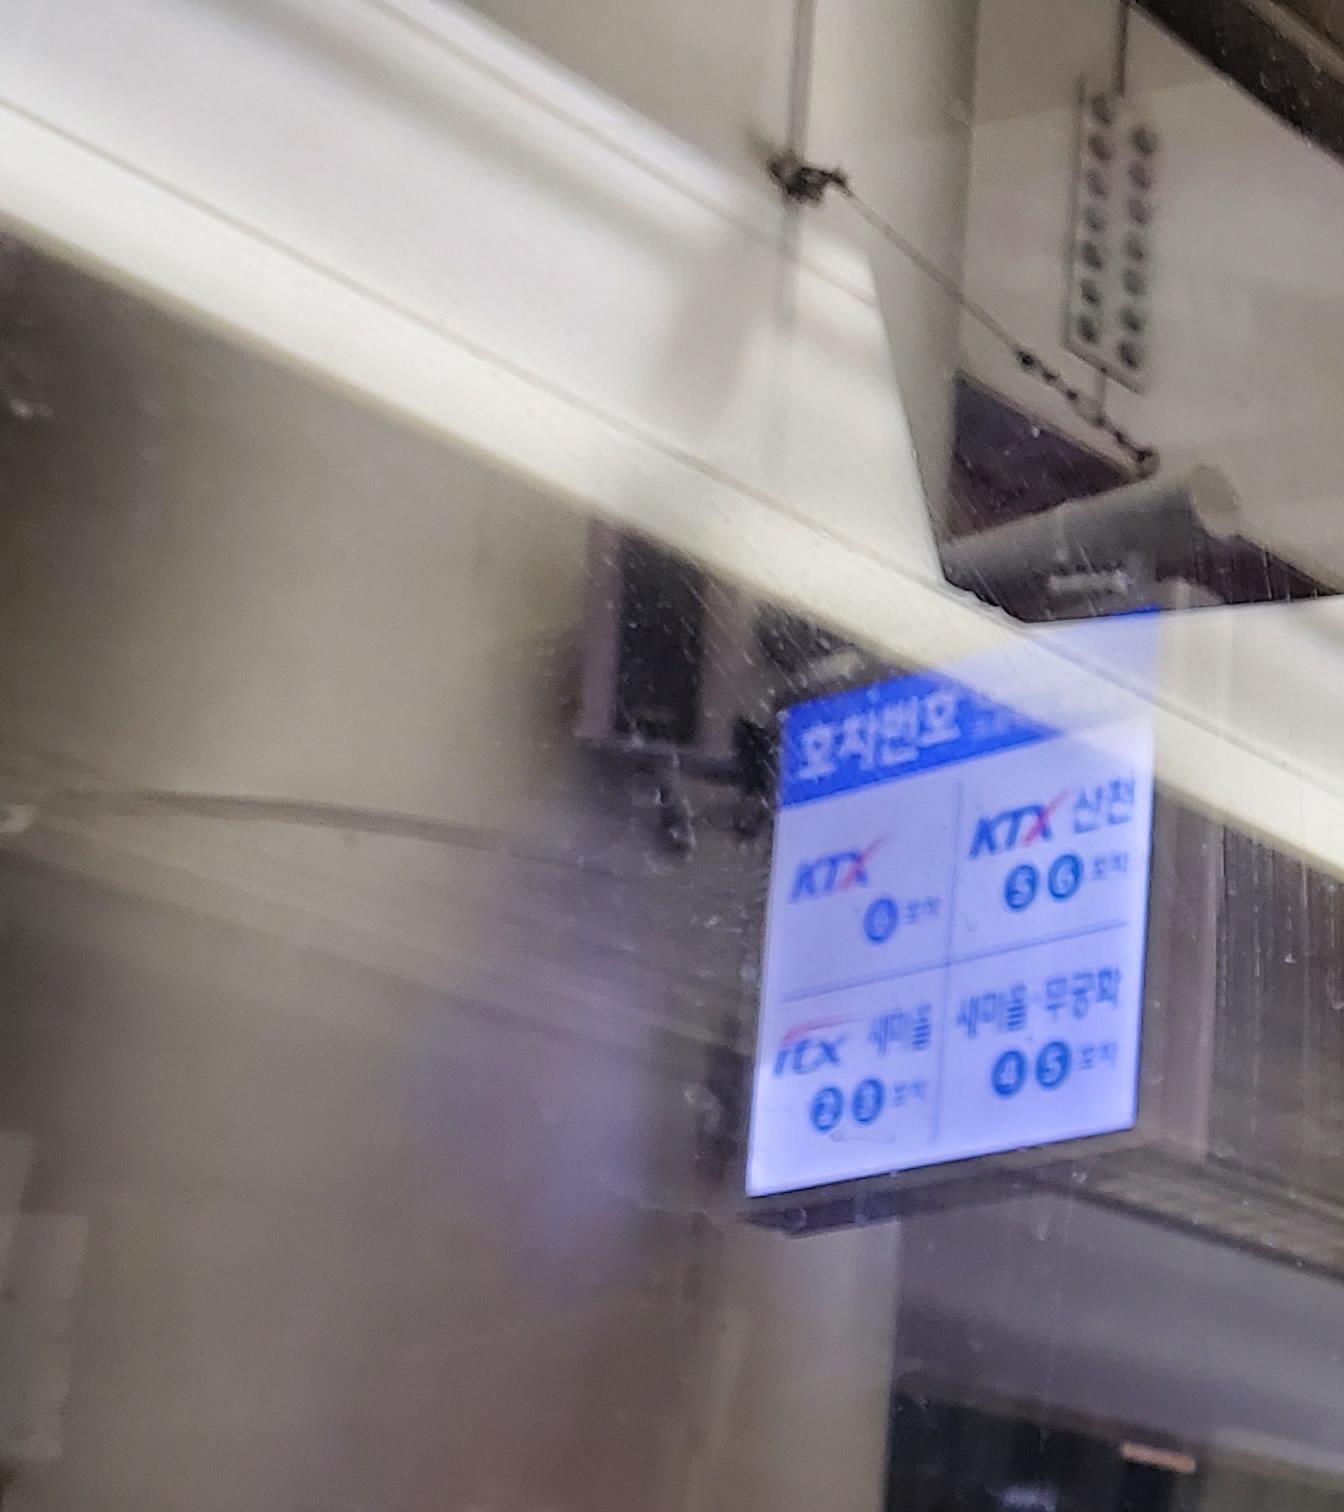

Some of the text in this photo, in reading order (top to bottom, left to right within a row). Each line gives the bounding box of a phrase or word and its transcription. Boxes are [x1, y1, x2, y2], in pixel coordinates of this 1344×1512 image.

[969, 776, 1135, 860] KTX 산천
[790, 834, 885, 903] KTX
[1046, 965, 1122, 1023] 무궁화
